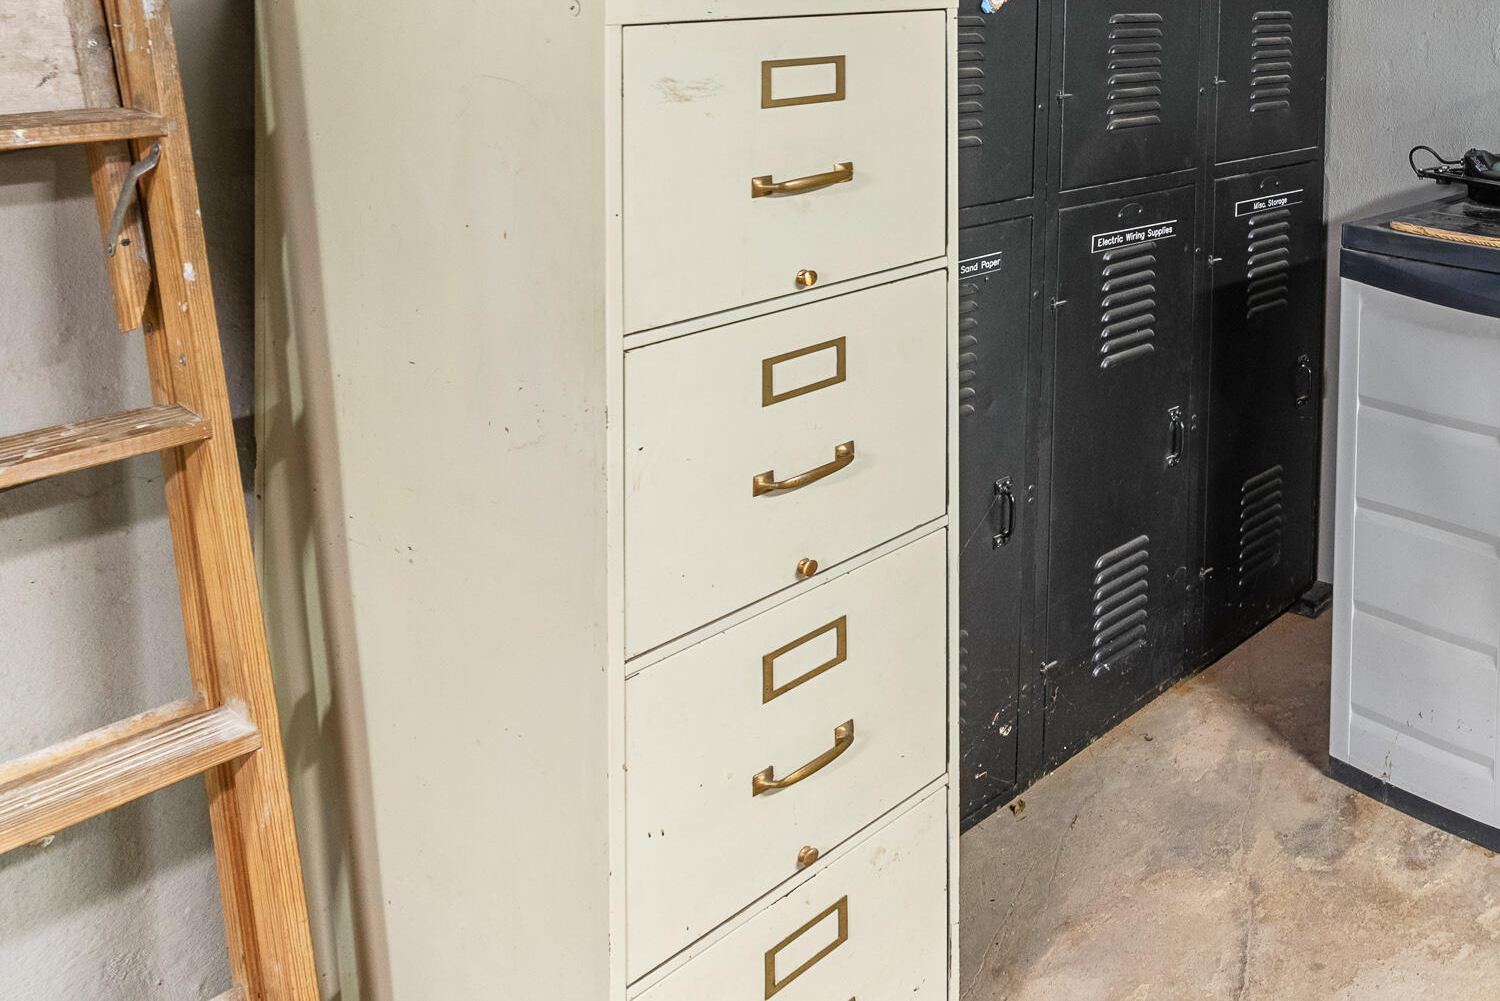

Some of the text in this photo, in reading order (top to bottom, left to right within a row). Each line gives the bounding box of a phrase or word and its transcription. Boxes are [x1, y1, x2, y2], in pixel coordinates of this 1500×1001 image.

[1267, 197, 1288, 207] Storage
[1097, 225, 1173, 247] Electric Wiring Supplies
[960, 258, 1001, 274] Sand Paper
